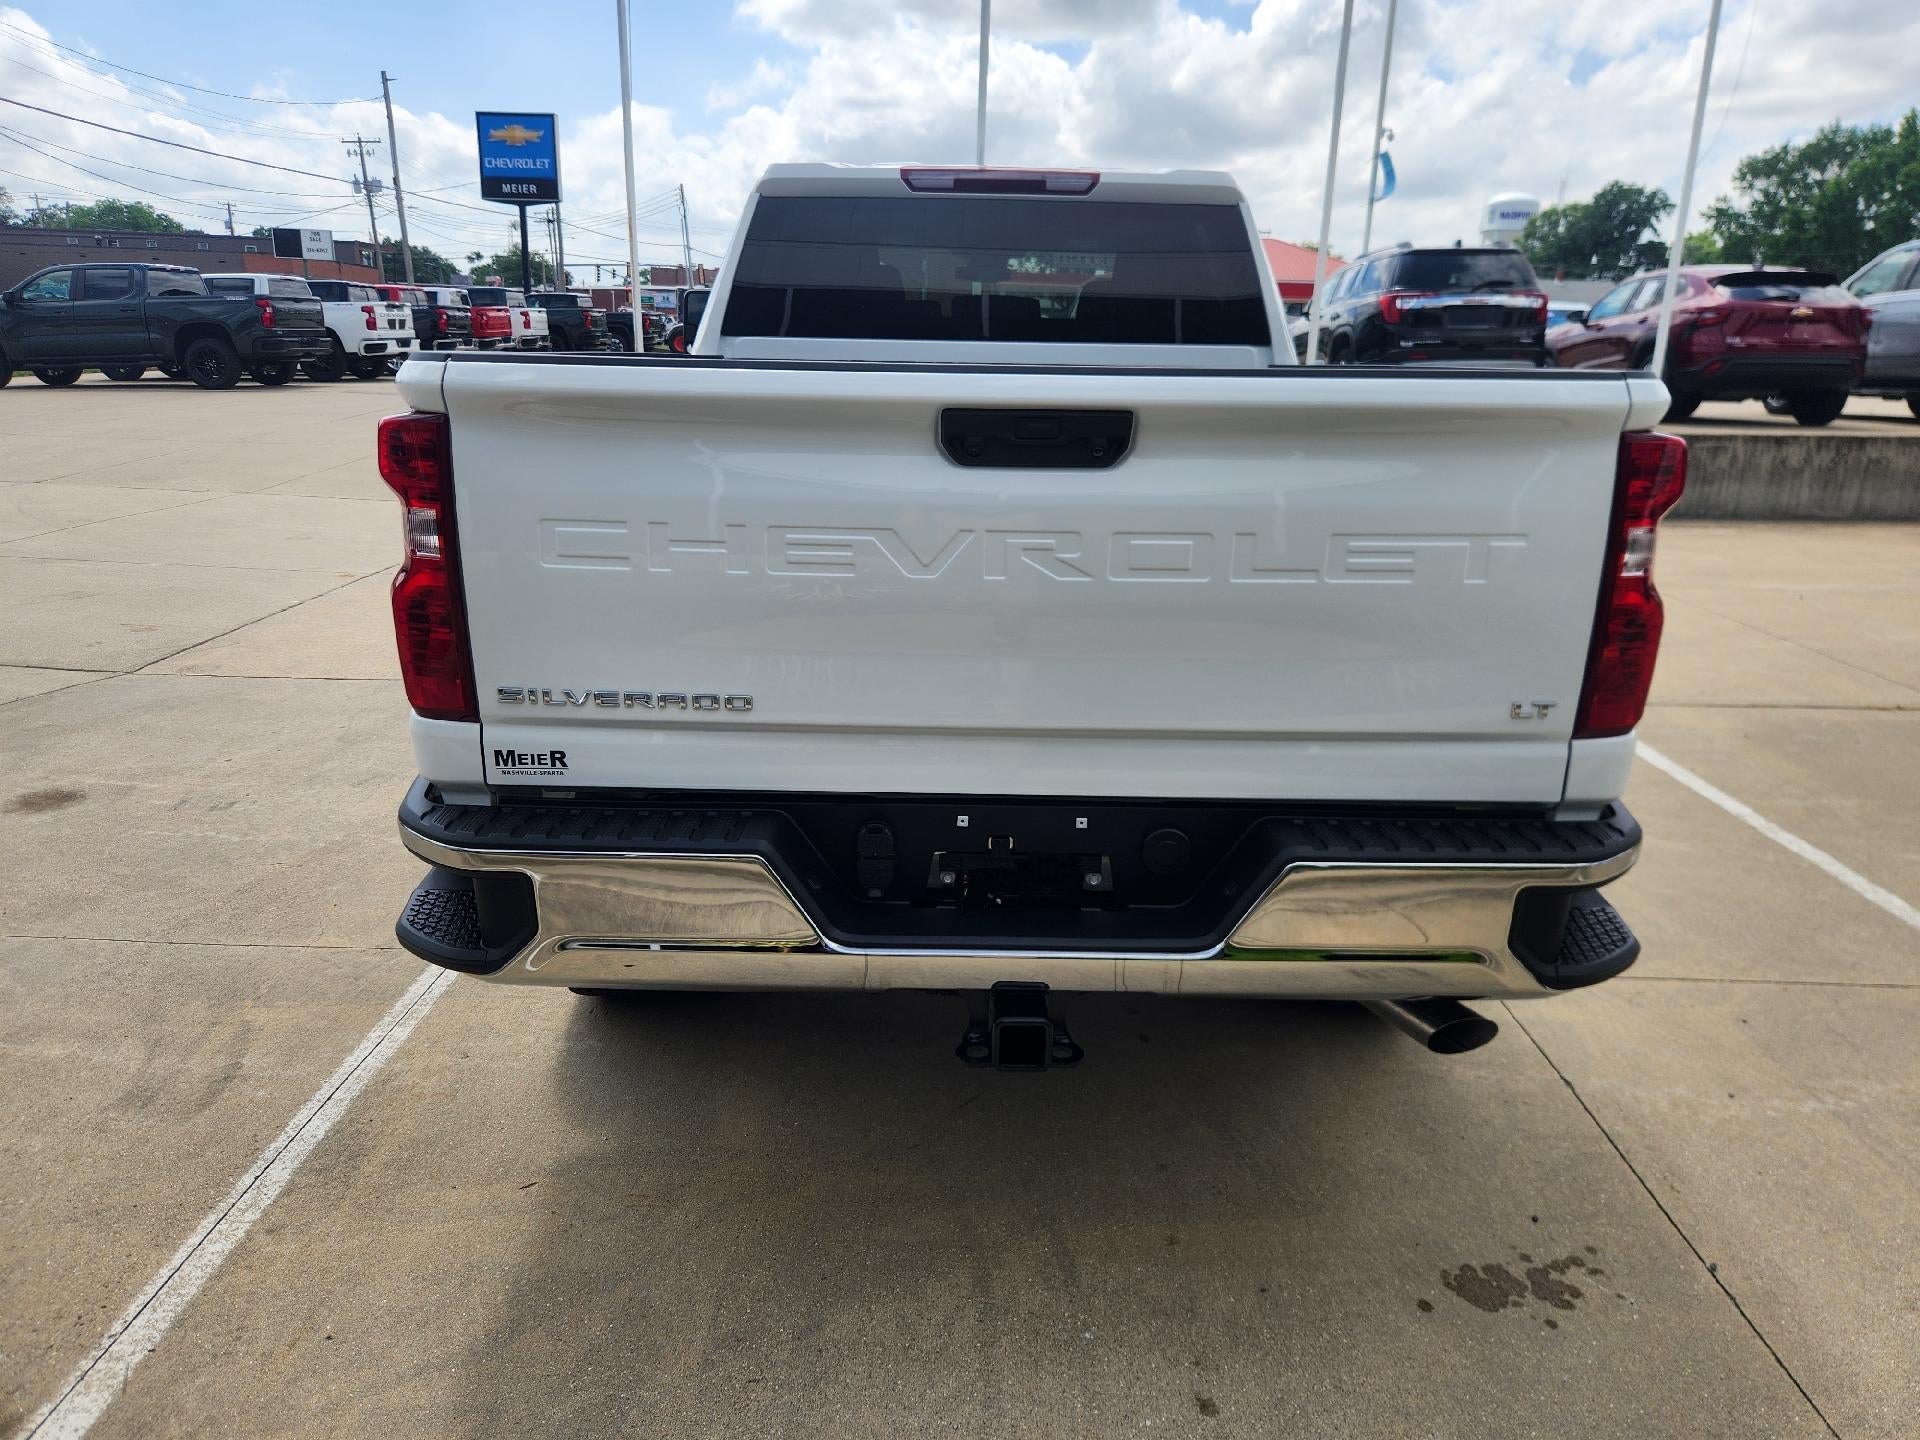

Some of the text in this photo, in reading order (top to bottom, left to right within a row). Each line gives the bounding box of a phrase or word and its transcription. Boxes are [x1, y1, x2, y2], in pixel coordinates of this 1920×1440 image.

[484, 157, 550, 169] CHEVROLET
[502, 183, 537, 194] MEIER
[538, 518, 1529, 587] CHEVROLET
[497, 687, 754, 711] SILVERADO
[1511, 701, 1558, 720] LT
